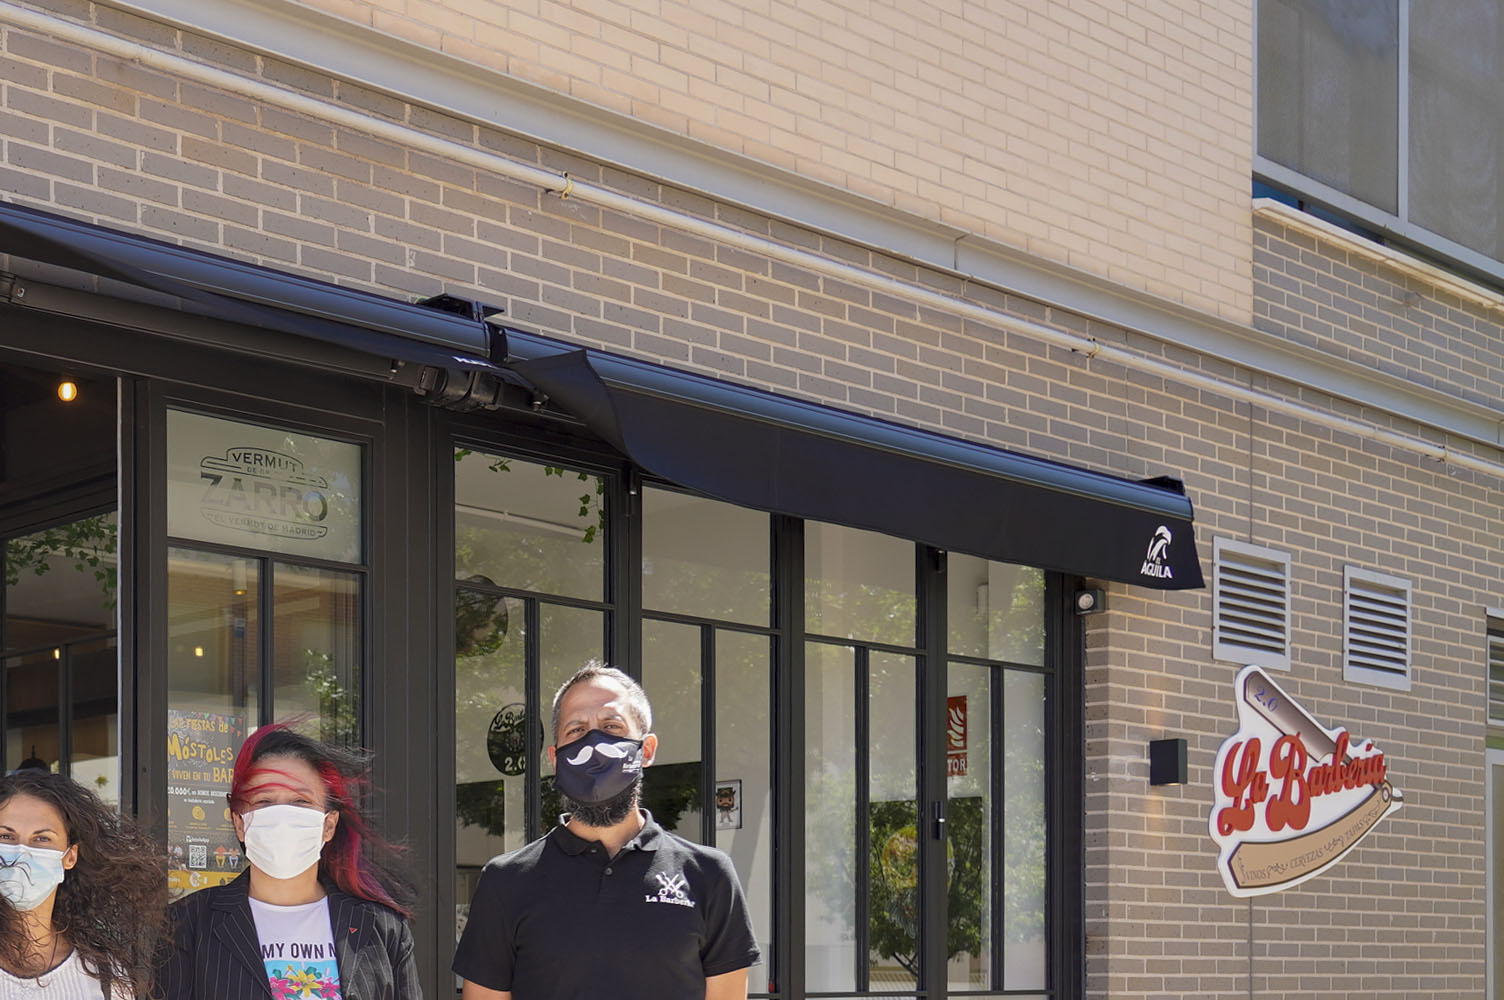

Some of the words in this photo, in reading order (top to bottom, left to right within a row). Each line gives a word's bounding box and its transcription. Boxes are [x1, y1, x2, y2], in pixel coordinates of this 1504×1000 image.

[232, 452, 297, 473] VERMUT
[201, 471, 328, 522] ZARRO
[1254, 685, 1280, 713] 2.0
[186, 719, 215, 732] FIESTAS
[218, 721, 229, 734] de
[947, 758, 966, 773] TOR
[1217, 737, 1270, 837] La
[262, 943, 285, 960] MY
[290, 942, 325, 960] OWN
